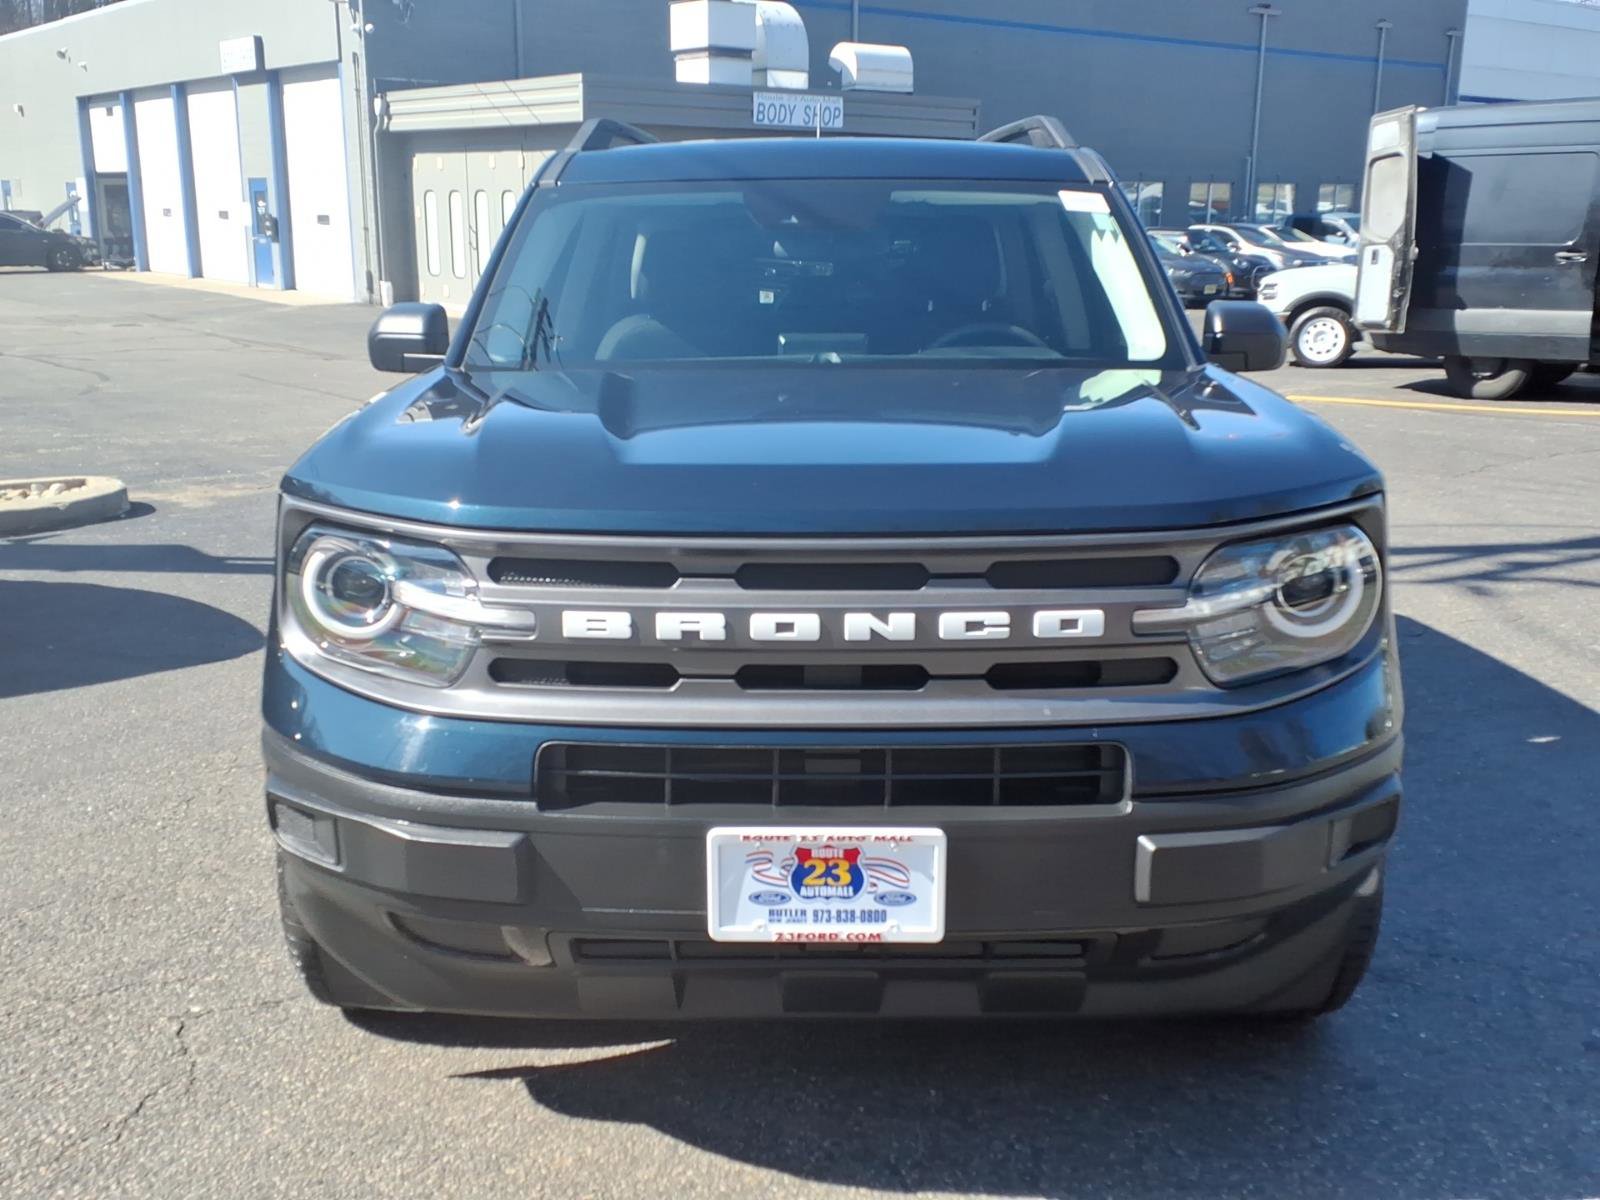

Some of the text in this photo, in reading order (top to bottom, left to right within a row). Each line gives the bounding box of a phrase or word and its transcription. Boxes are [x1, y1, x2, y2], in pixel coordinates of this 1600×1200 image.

[756, 102, 841, 126] BODY SHOP
[562, 610, 1105, 641] BRONCO
[802, 859, 852, 886] 23
[800, 885, 855, 897] AUTOMALL
[812, 909, 888, 924] 973-838-0800
[775, 932, 882, 942] 23FORD.COM
